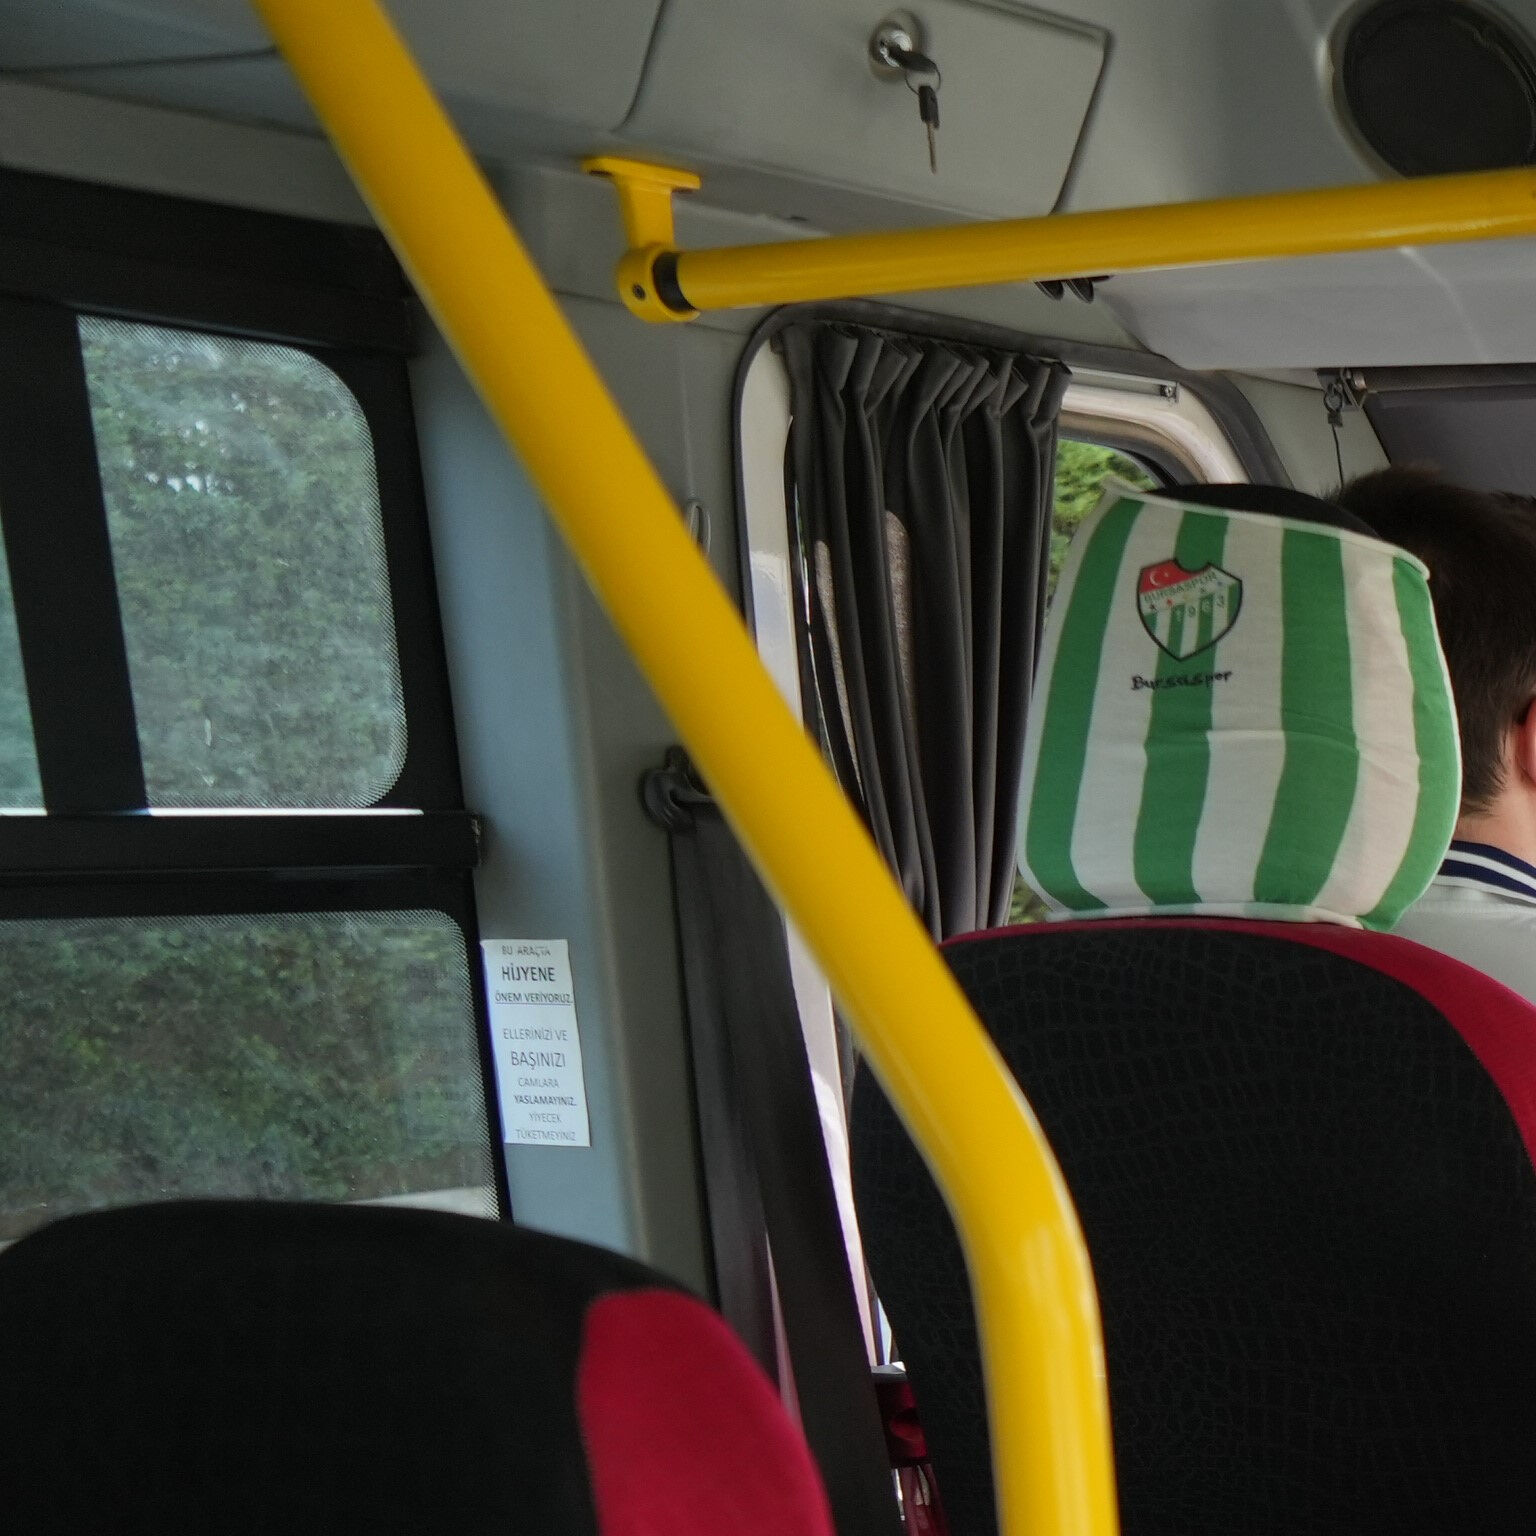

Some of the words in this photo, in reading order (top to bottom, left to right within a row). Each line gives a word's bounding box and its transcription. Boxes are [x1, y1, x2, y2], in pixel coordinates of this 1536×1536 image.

[495, 991, 522, 1003] ÖNEM
[555, 1029, 568, 1041] VE
[511, 1051, 566, 1071] BAŞINIZI
